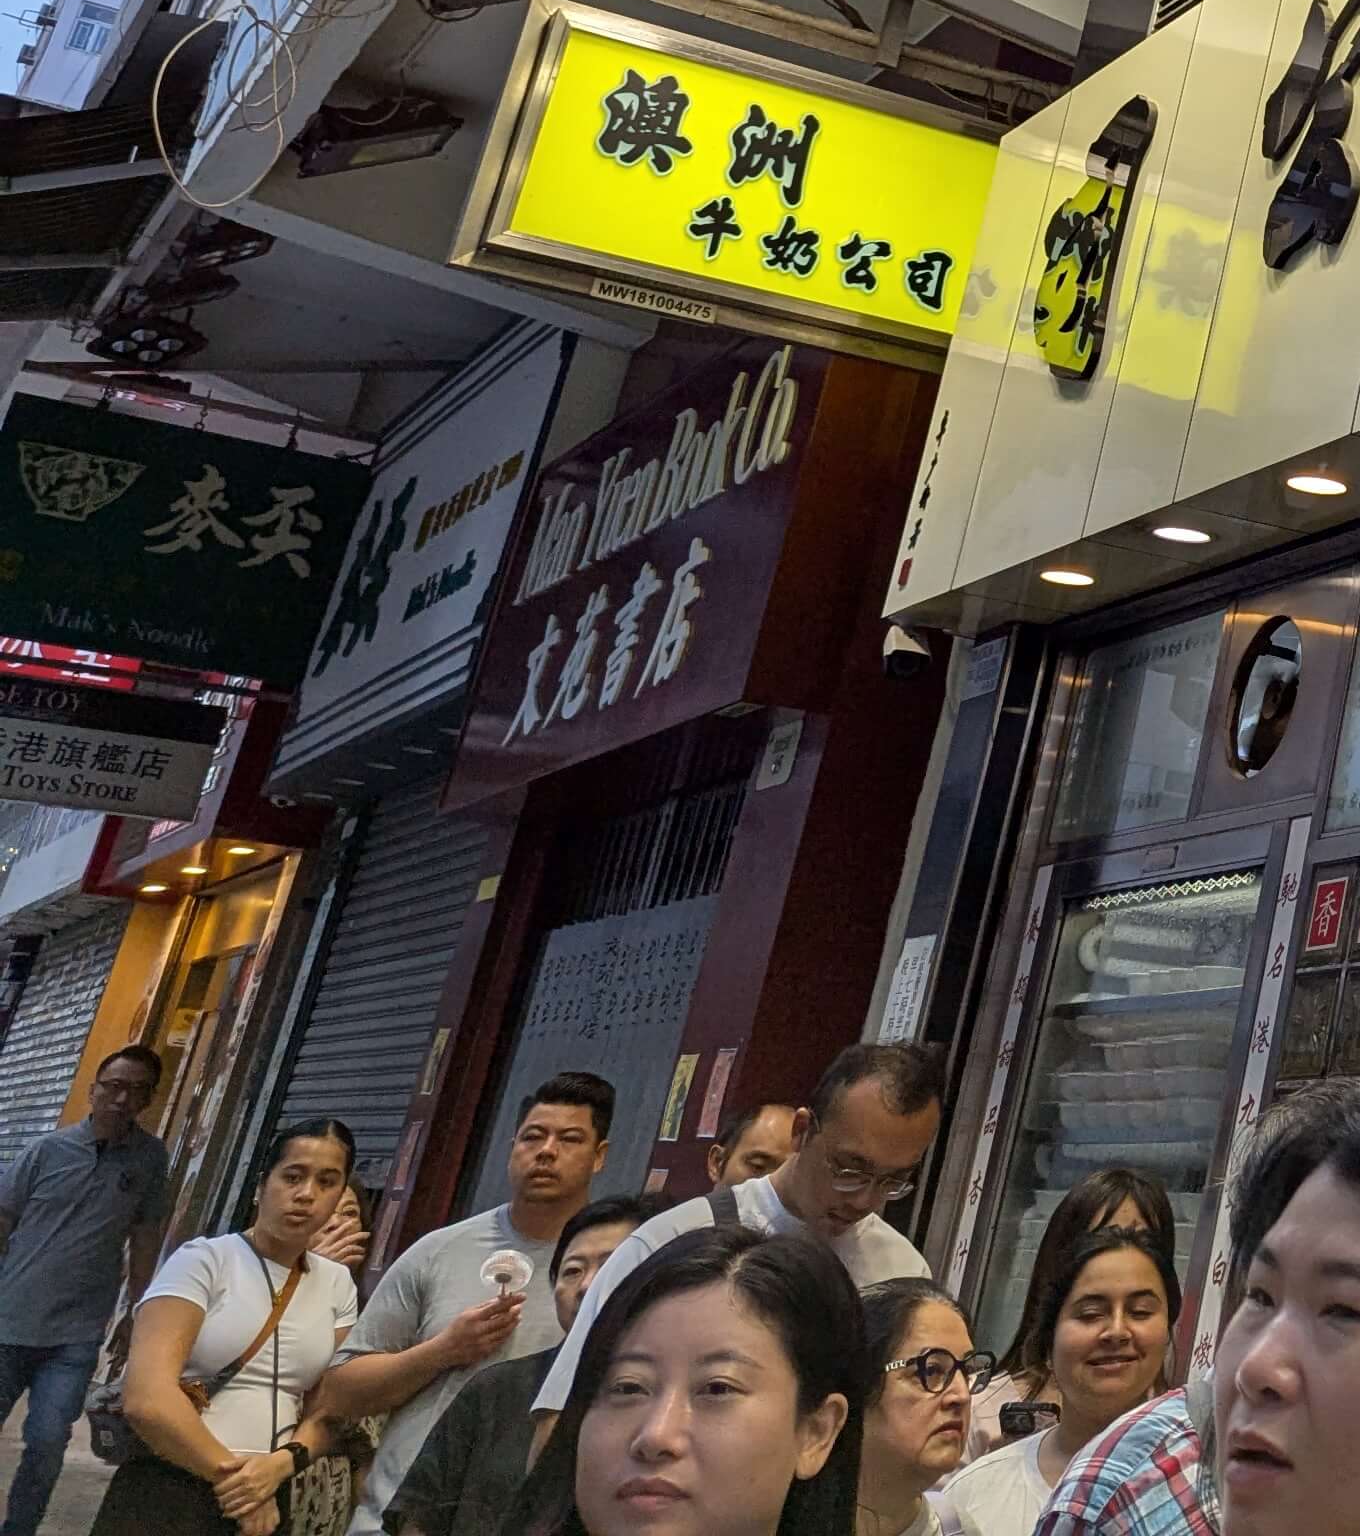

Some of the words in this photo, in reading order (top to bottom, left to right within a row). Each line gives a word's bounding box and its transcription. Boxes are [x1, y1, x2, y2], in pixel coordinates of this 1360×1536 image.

[597, 68, 820, 207] 澳洲
[597, 280, 713, 320] MW181004475
[687, 195, 955, 311] 牛奶公司
